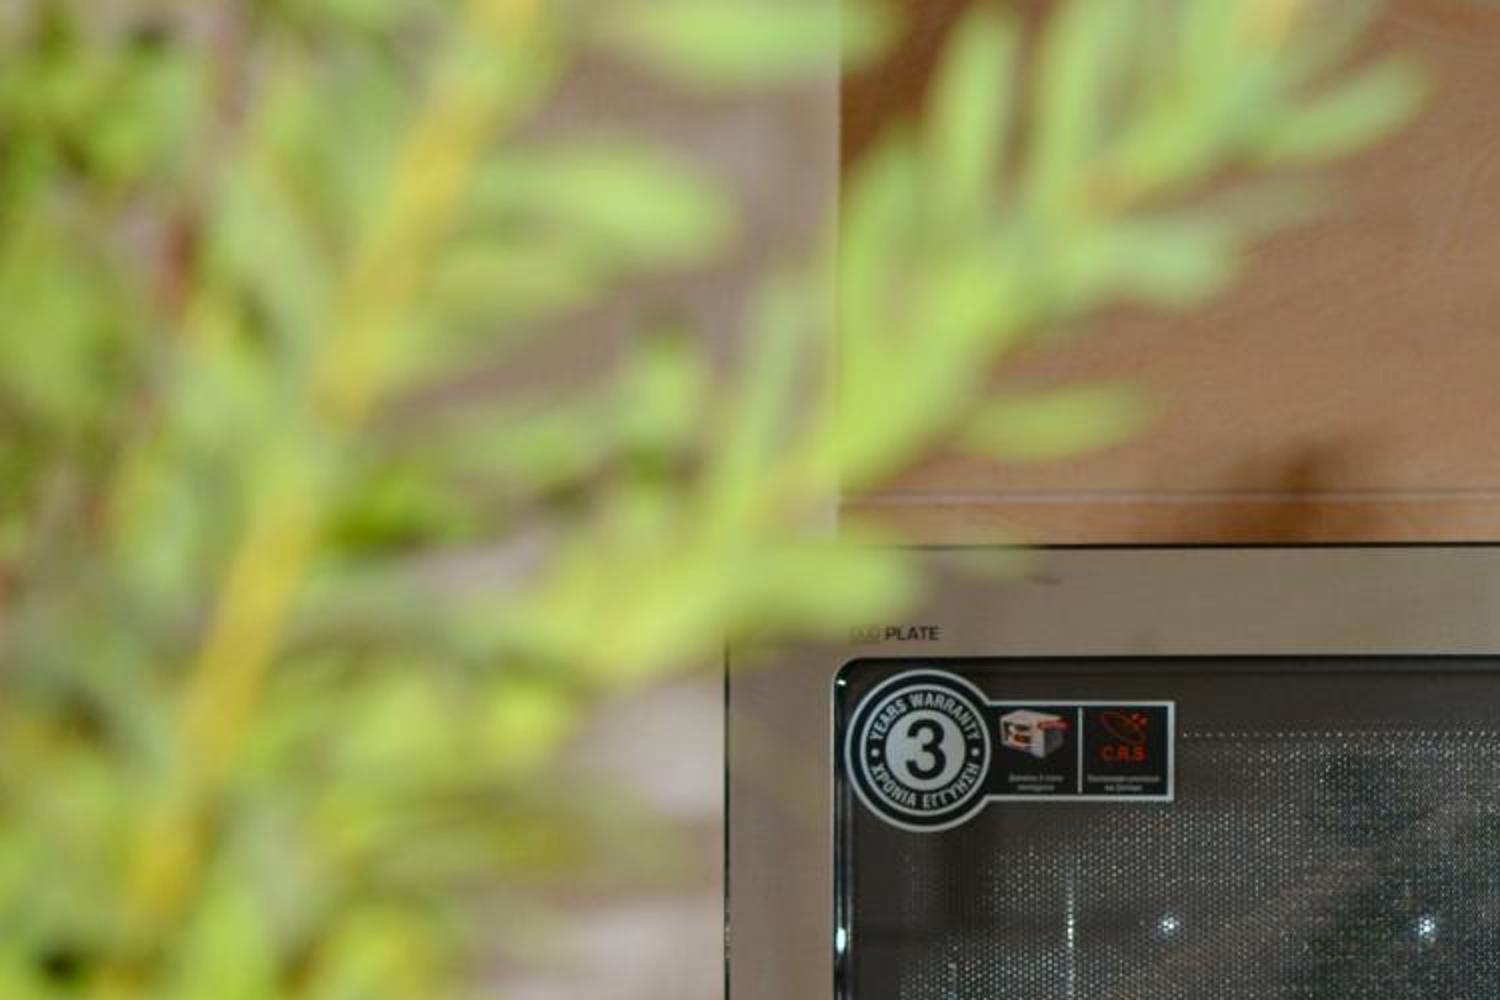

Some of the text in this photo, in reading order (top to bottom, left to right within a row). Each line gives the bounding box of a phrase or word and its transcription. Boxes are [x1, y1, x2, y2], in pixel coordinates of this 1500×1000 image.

[884, 625, 941, 641] PLATE
[870, 691, 981, 741] YEARS WARRANTY
[905, 718, 947, 781] 3
